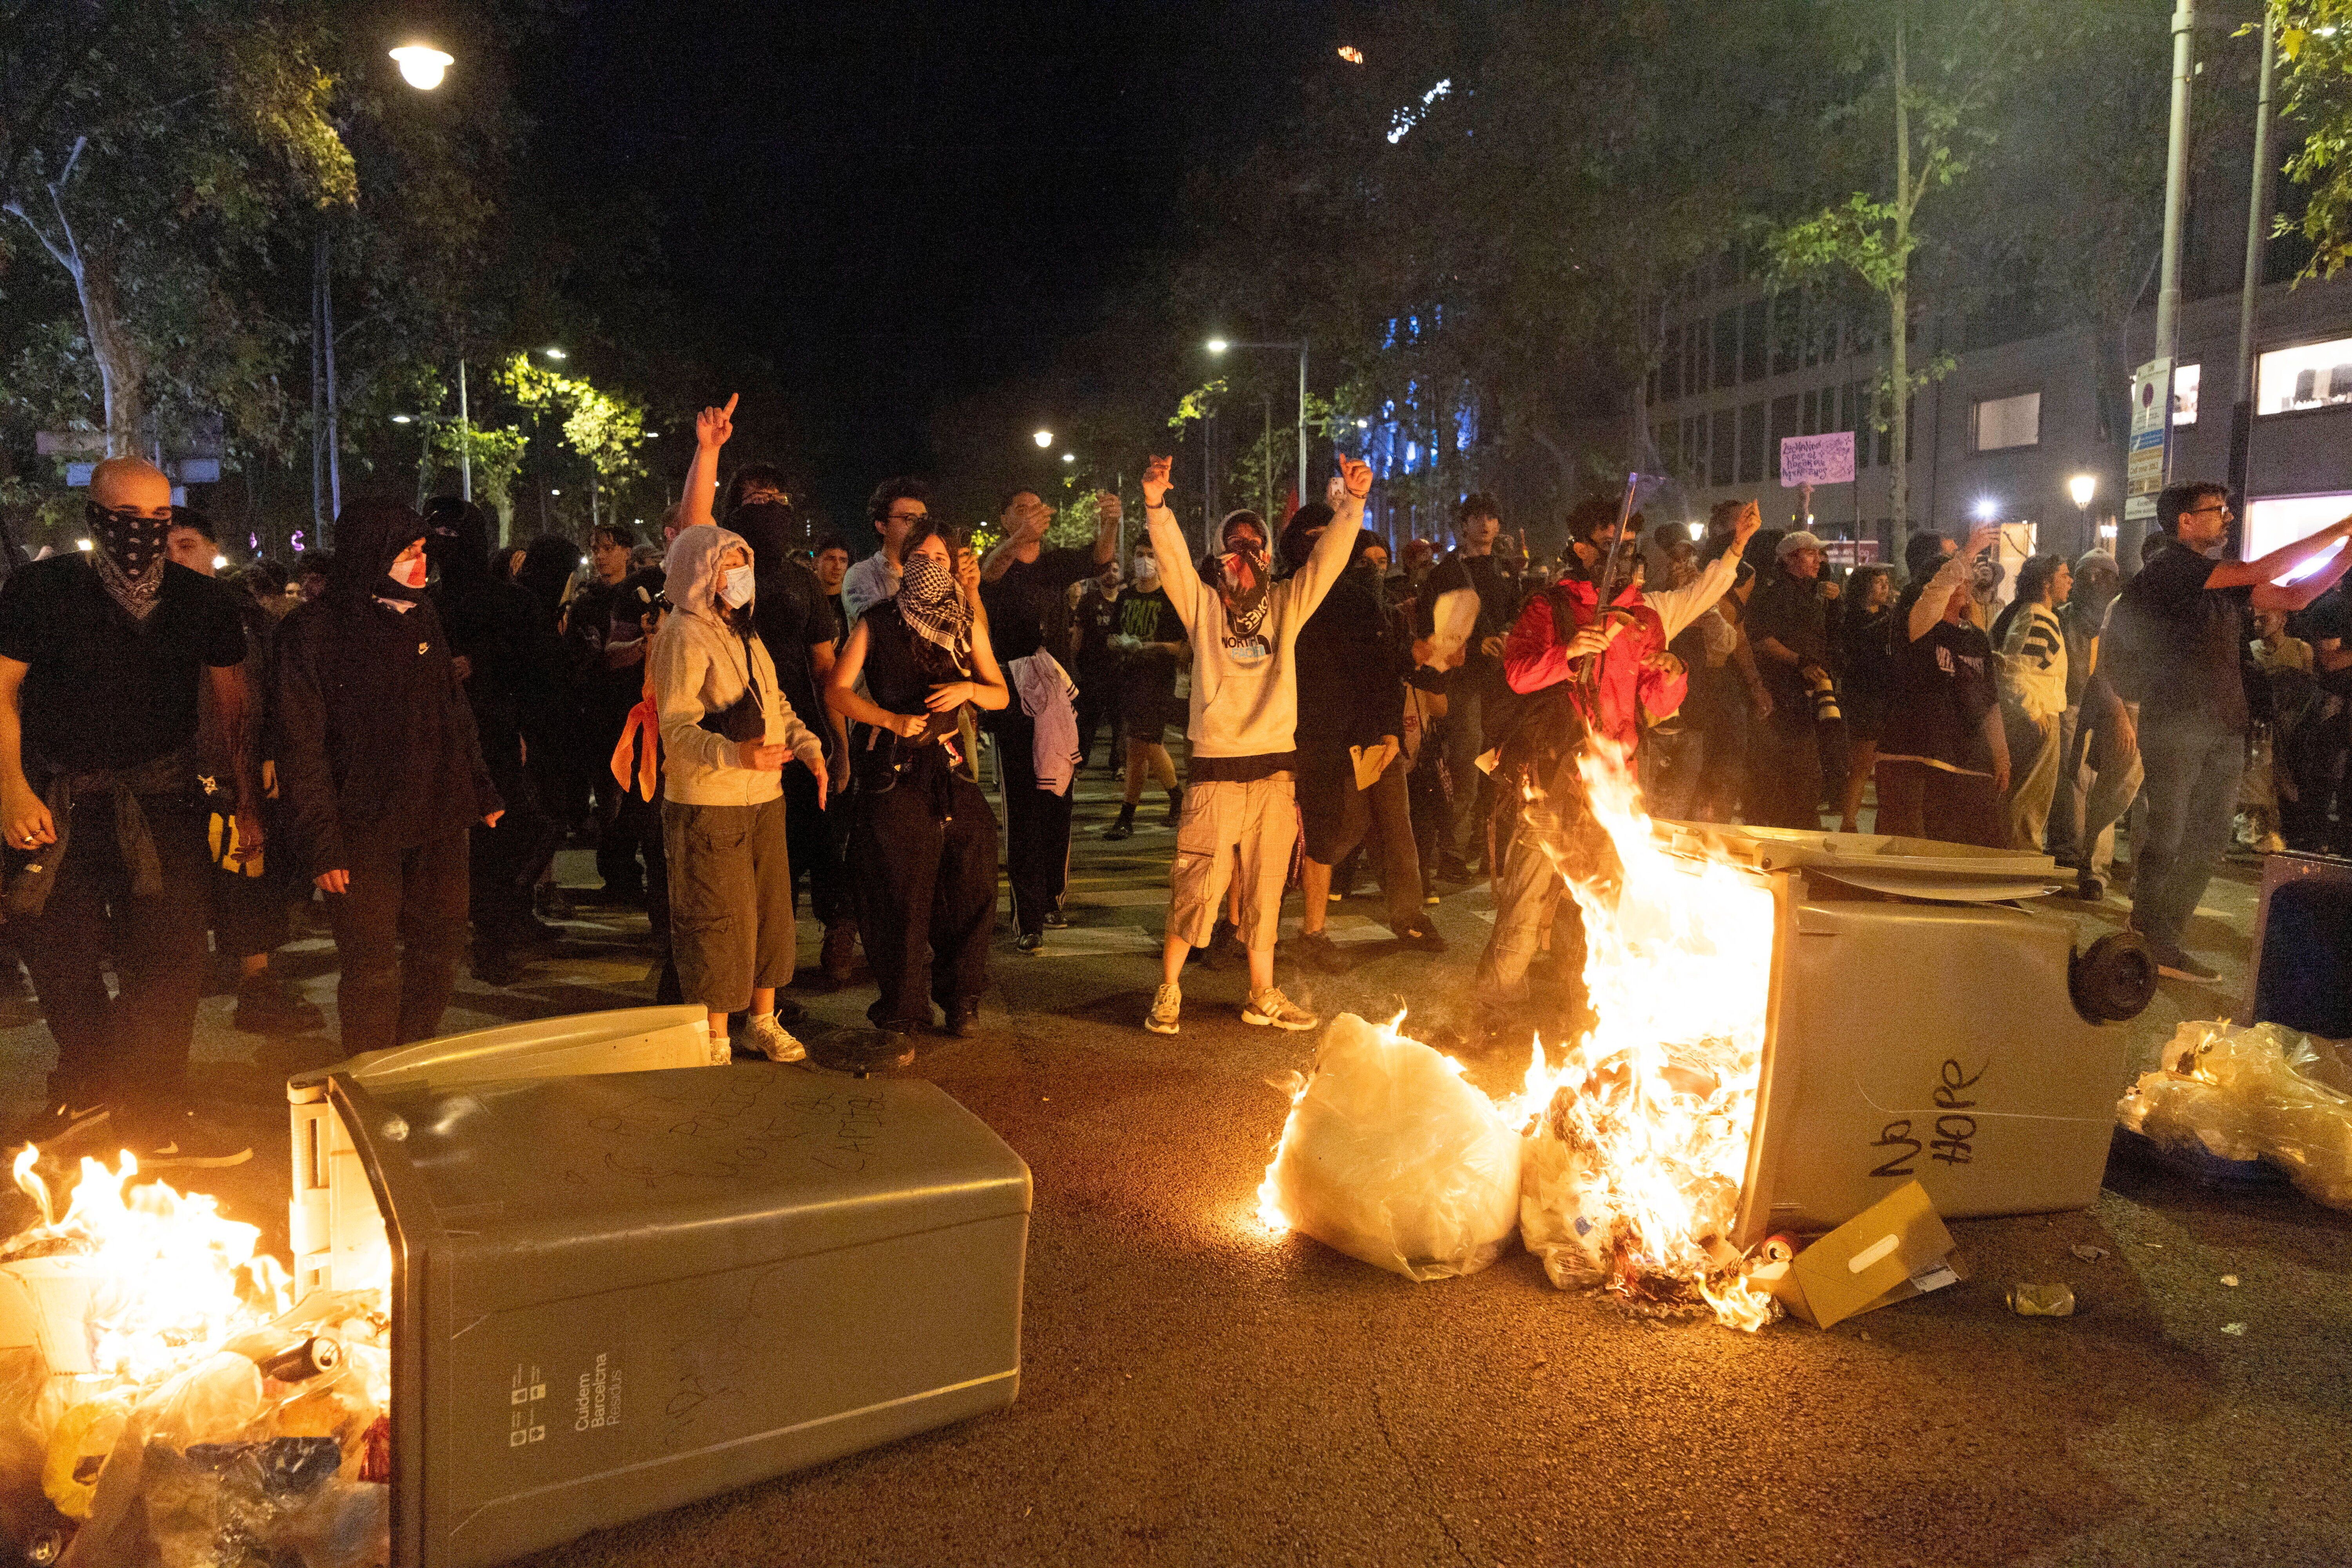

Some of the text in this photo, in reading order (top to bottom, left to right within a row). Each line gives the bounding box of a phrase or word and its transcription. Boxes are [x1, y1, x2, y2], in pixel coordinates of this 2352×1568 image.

[575, 1373, 590, 1432] Cuidem
[591, 1352, 607, 1428] Barcelona
[607, 1369, 622, 1426] Residus
